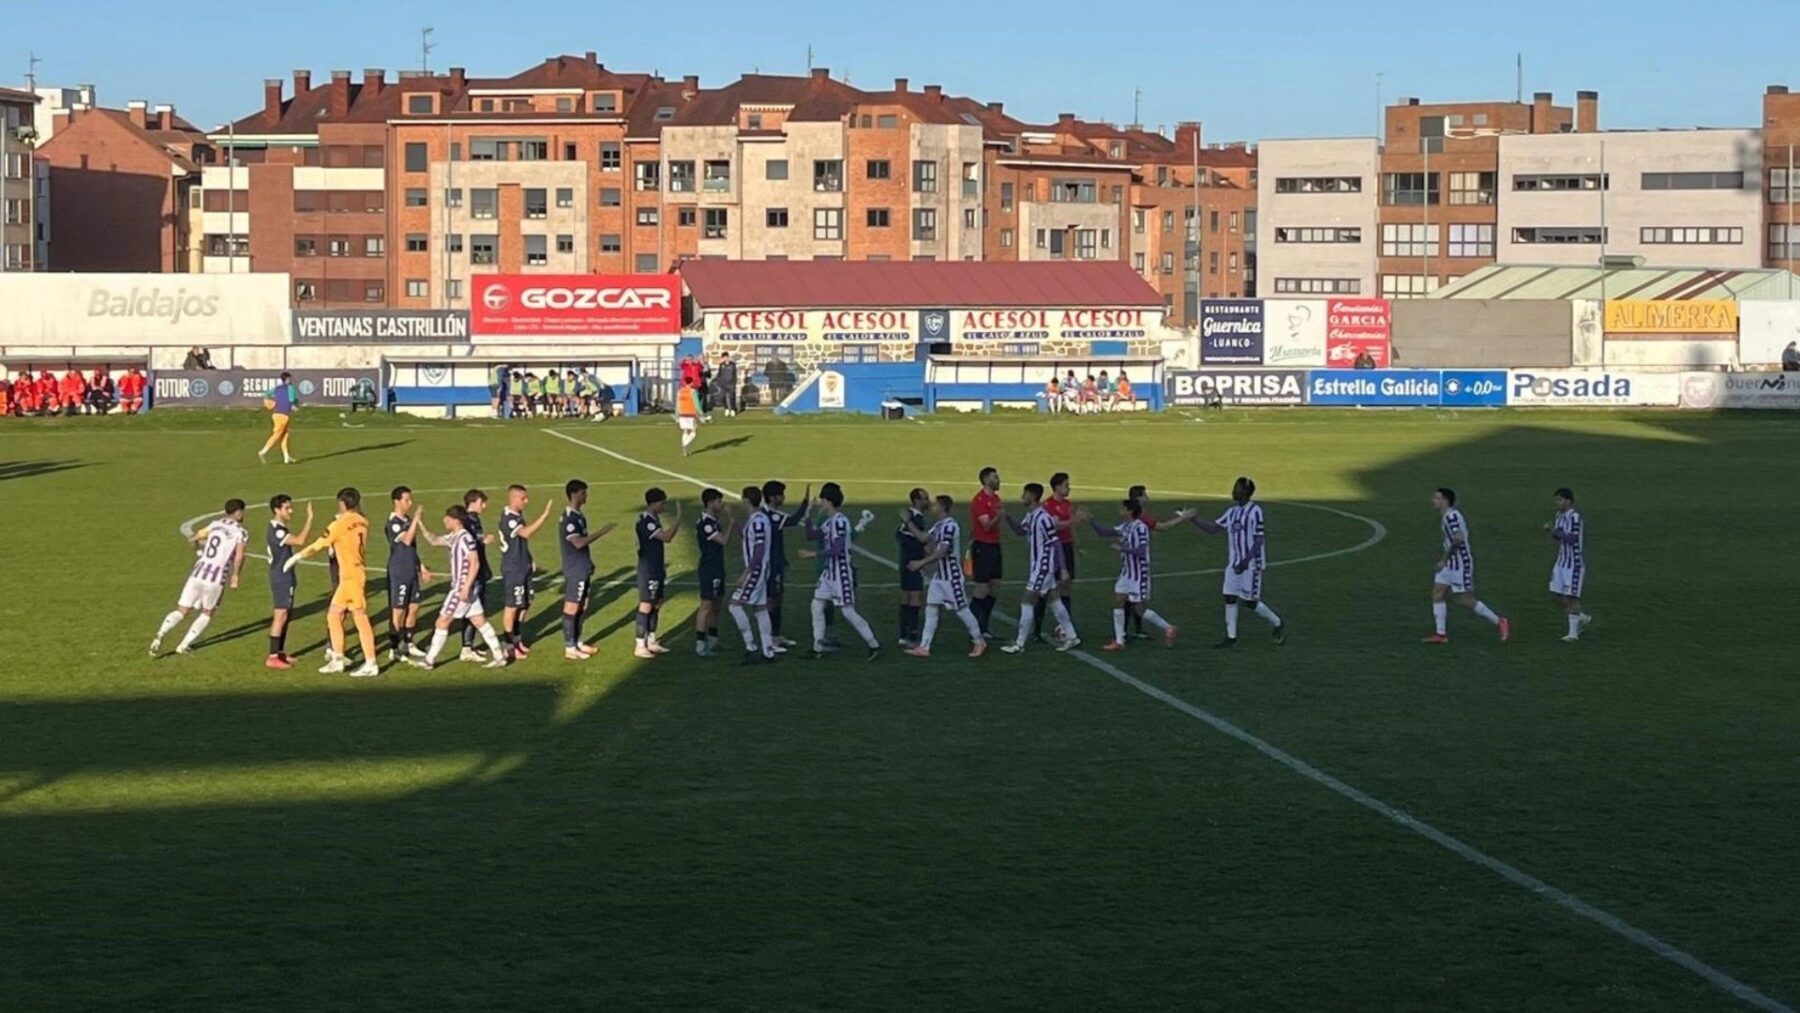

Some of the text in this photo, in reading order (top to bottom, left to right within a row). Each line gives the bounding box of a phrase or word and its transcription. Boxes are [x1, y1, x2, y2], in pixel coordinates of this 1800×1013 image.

[87, 287, 219, 324] Baldajos
[521, 288, 671, 309] GOZCAR
[297, 314, 466, 337] VENTANAS CASTRILLÓN
[719, 312, 808, 330] ACESOL
[822, 312, 910, 330] ACESOL
[963, 311, 1049, 329] ACESOL
[1061, 310, 1145, 328] ACESOL
[1329, 315, 1386, 325] GARCIA
[1613, 304, 1733, 328] ALIMERKA
[1203, 317, 1261, 337] Guernica
[243, 378, 285, 391] SEGUN
[1175, 375, 1301, 395] BOPRISA
[1313, 378, 1439, 396] Estrella Galicia
[1514, 374, 1630, 397] Posada
[206, 535, 221, 559] 8
[399, 584, 411, 595] 2
